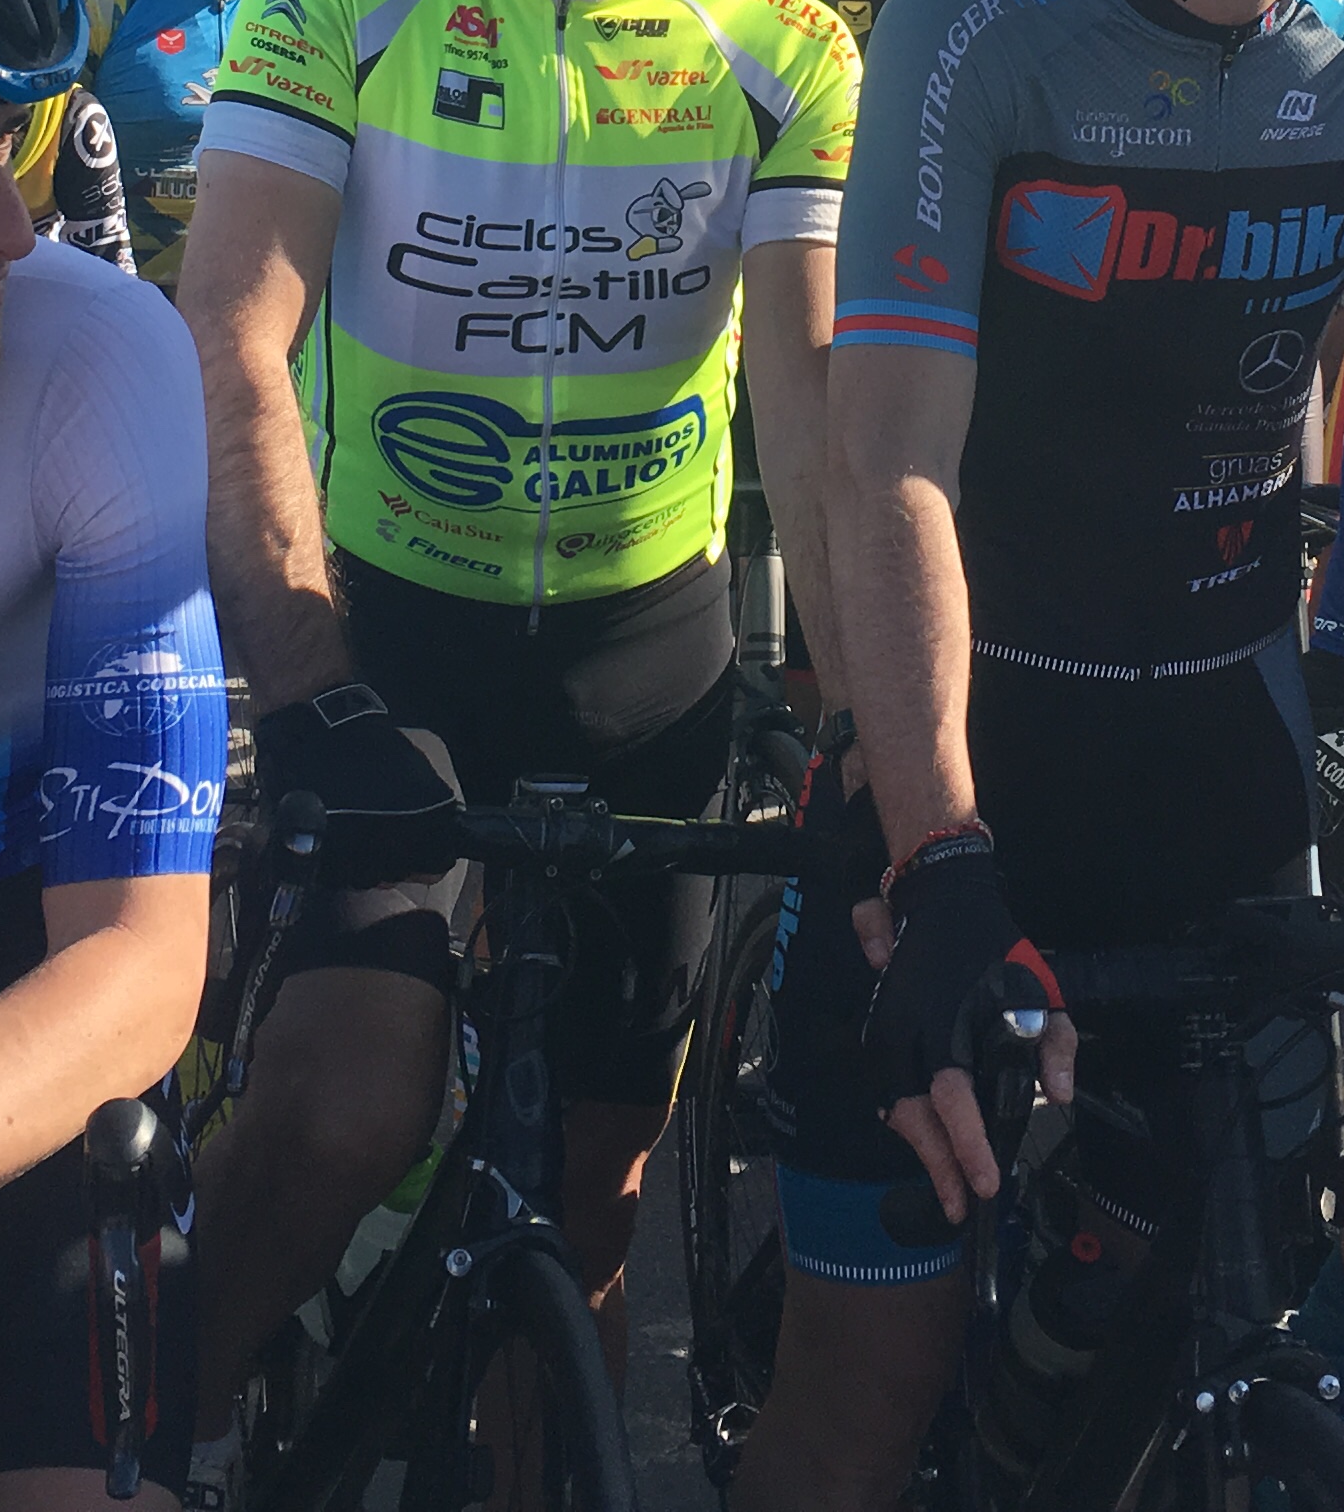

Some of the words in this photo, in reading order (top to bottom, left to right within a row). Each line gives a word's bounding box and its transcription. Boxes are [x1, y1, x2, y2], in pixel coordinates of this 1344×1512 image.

[250, 37, 307, 66] COSERSA
[609, 105, 712, 125] GENERALI
[1259, 123, 1327, 142] INVERSE
[416, 210, 624, 255] Ciclos
[387, 242, 711, 302] Castillo
[455, 308, 646, 355] FCM
[523, 418, 695, 467] ALUMINIOS
[523, 447, 690, 505] GALIOT
[1209, 452, 1284, 485] gruas
[406, 536, 504, 577] Fineco
[111, 1268, 131, 1422] ULTEGRA
